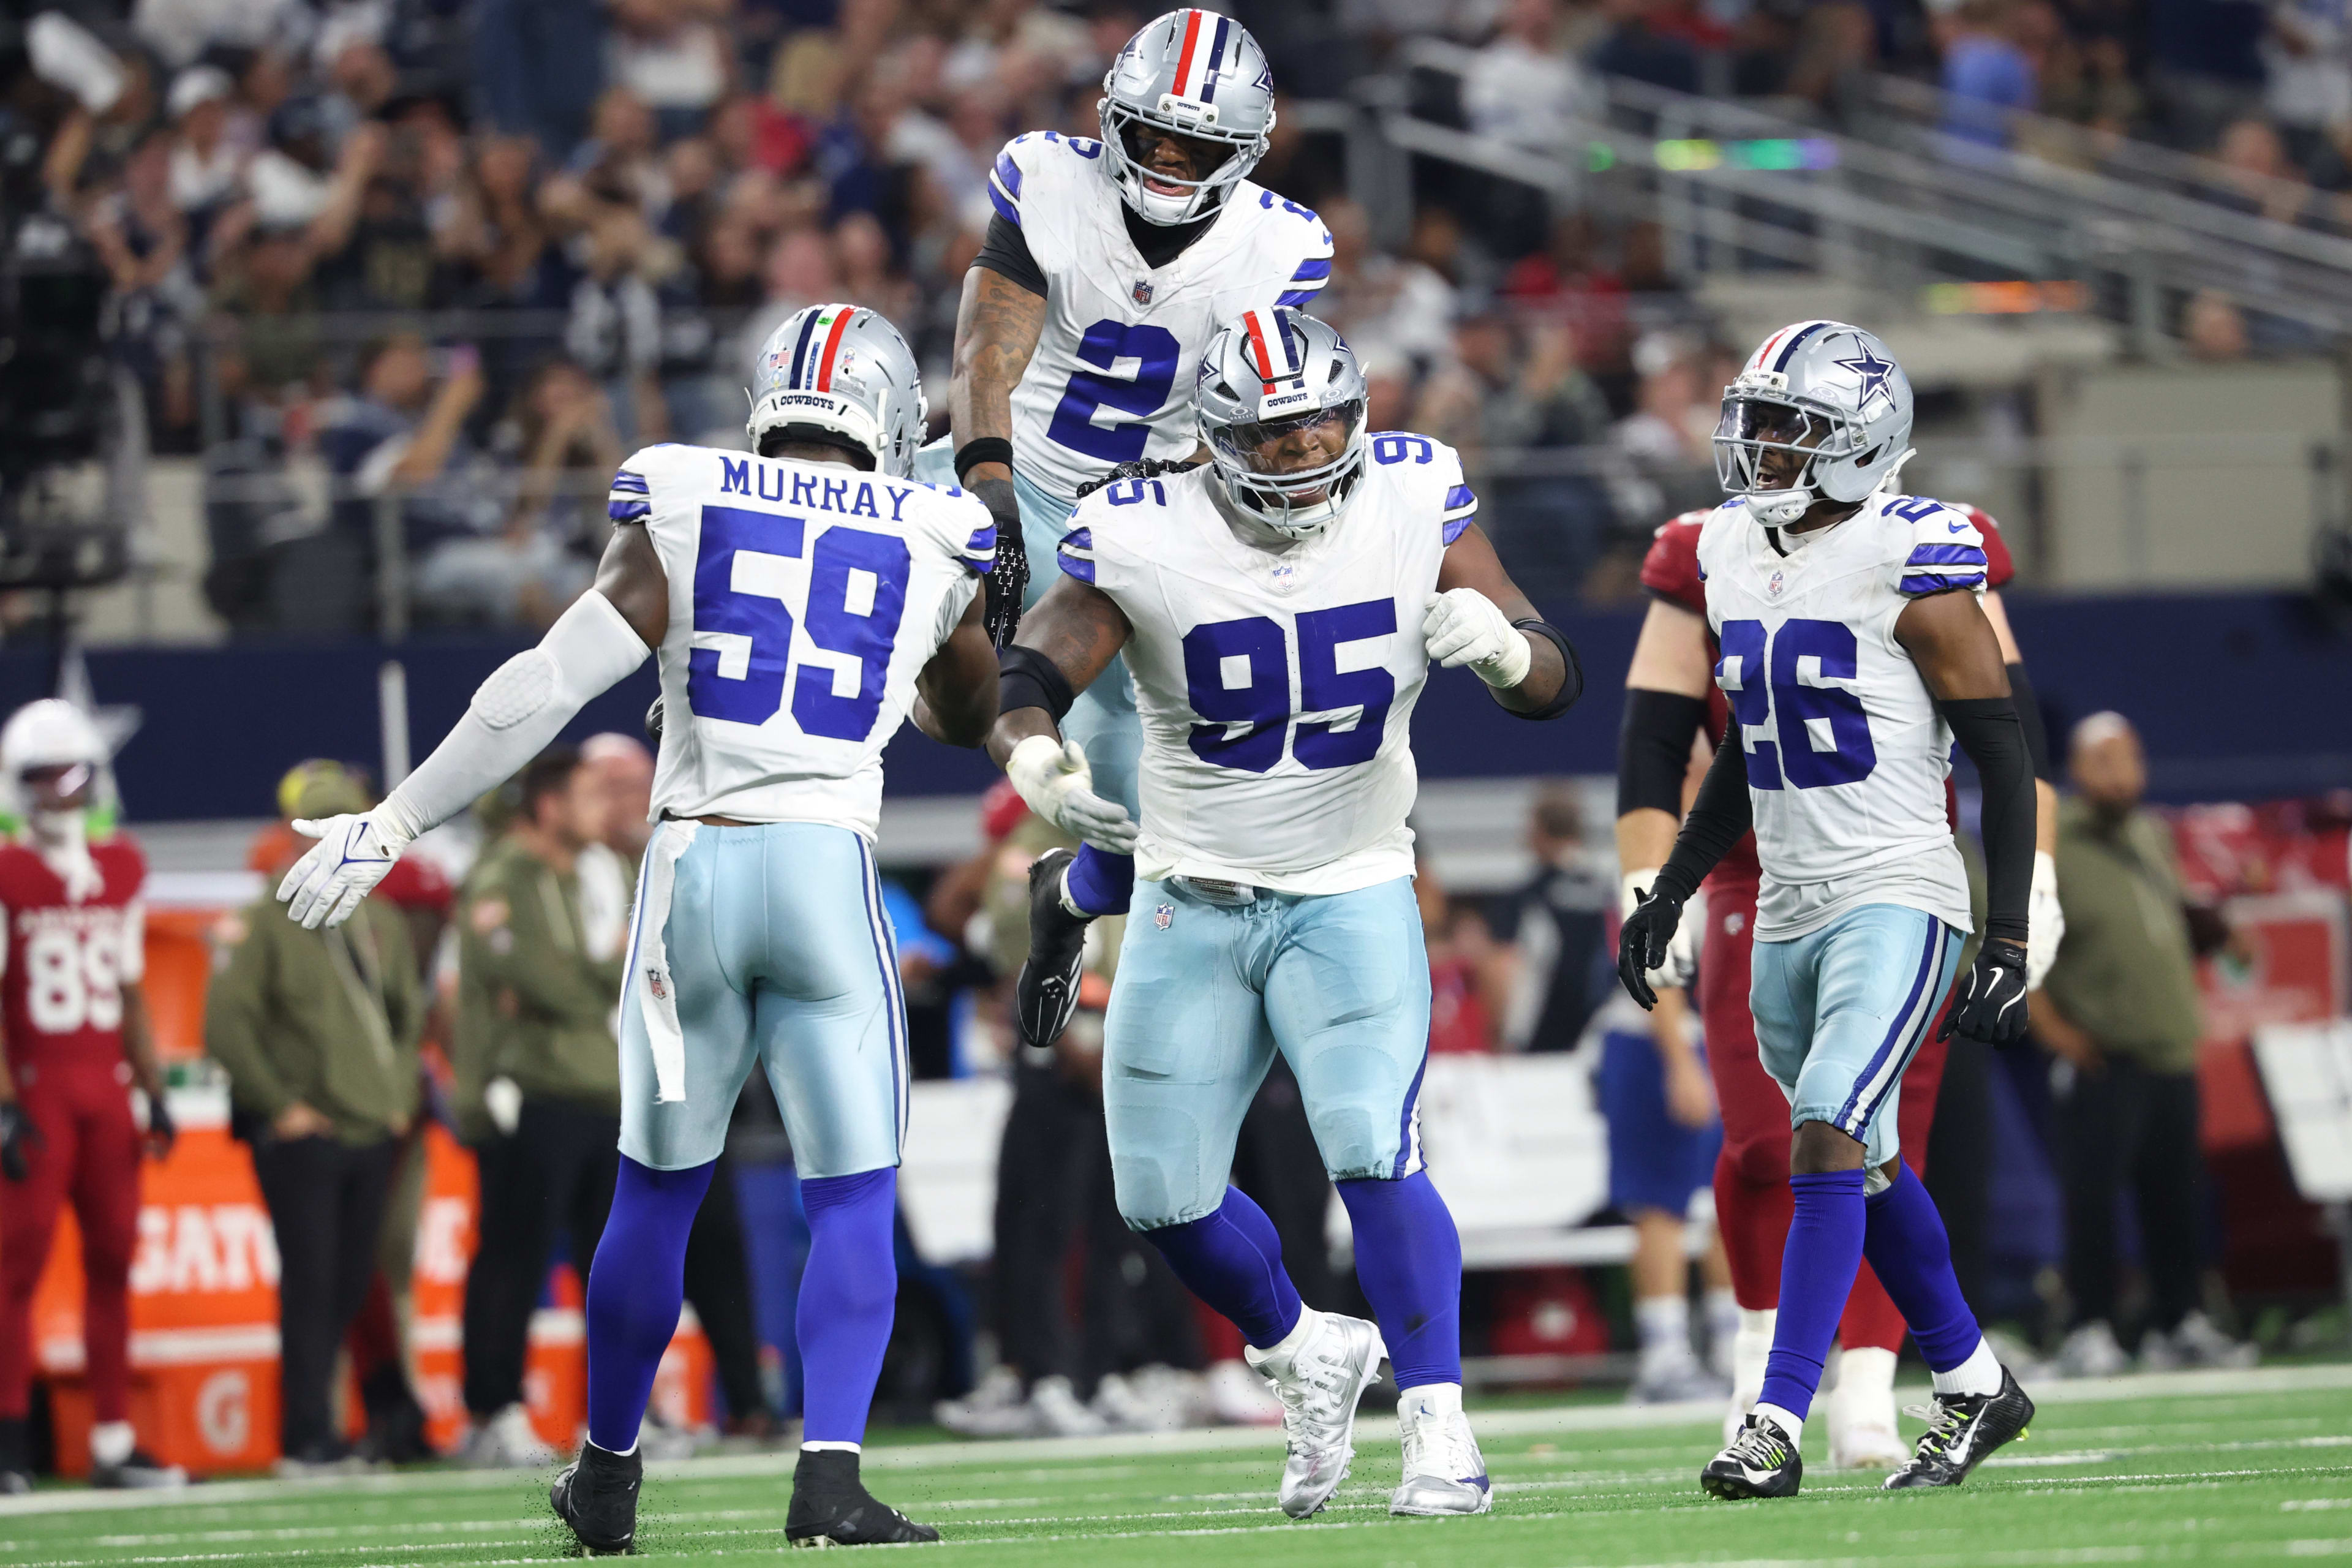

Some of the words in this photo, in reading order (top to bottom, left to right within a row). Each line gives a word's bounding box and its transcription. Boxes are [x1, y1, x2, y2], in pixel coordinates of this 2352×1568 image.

[1177, 102, 1200, 111] COWBOYS
[780, 395, 834, 410] COWBOYS
[1047, 318, 1180, 463] 2
[1267, 393, 1308, 407] COWBOYS
[718, 456, 914, 522] MURRAY
[687, 505, 912, 742] 59
[1182, 597, 1398, 774] 95
[1714, 618, 1877, 790] 26
[27, 934, 123, 1033] 89
[197, 1370, 251, 1455] G
